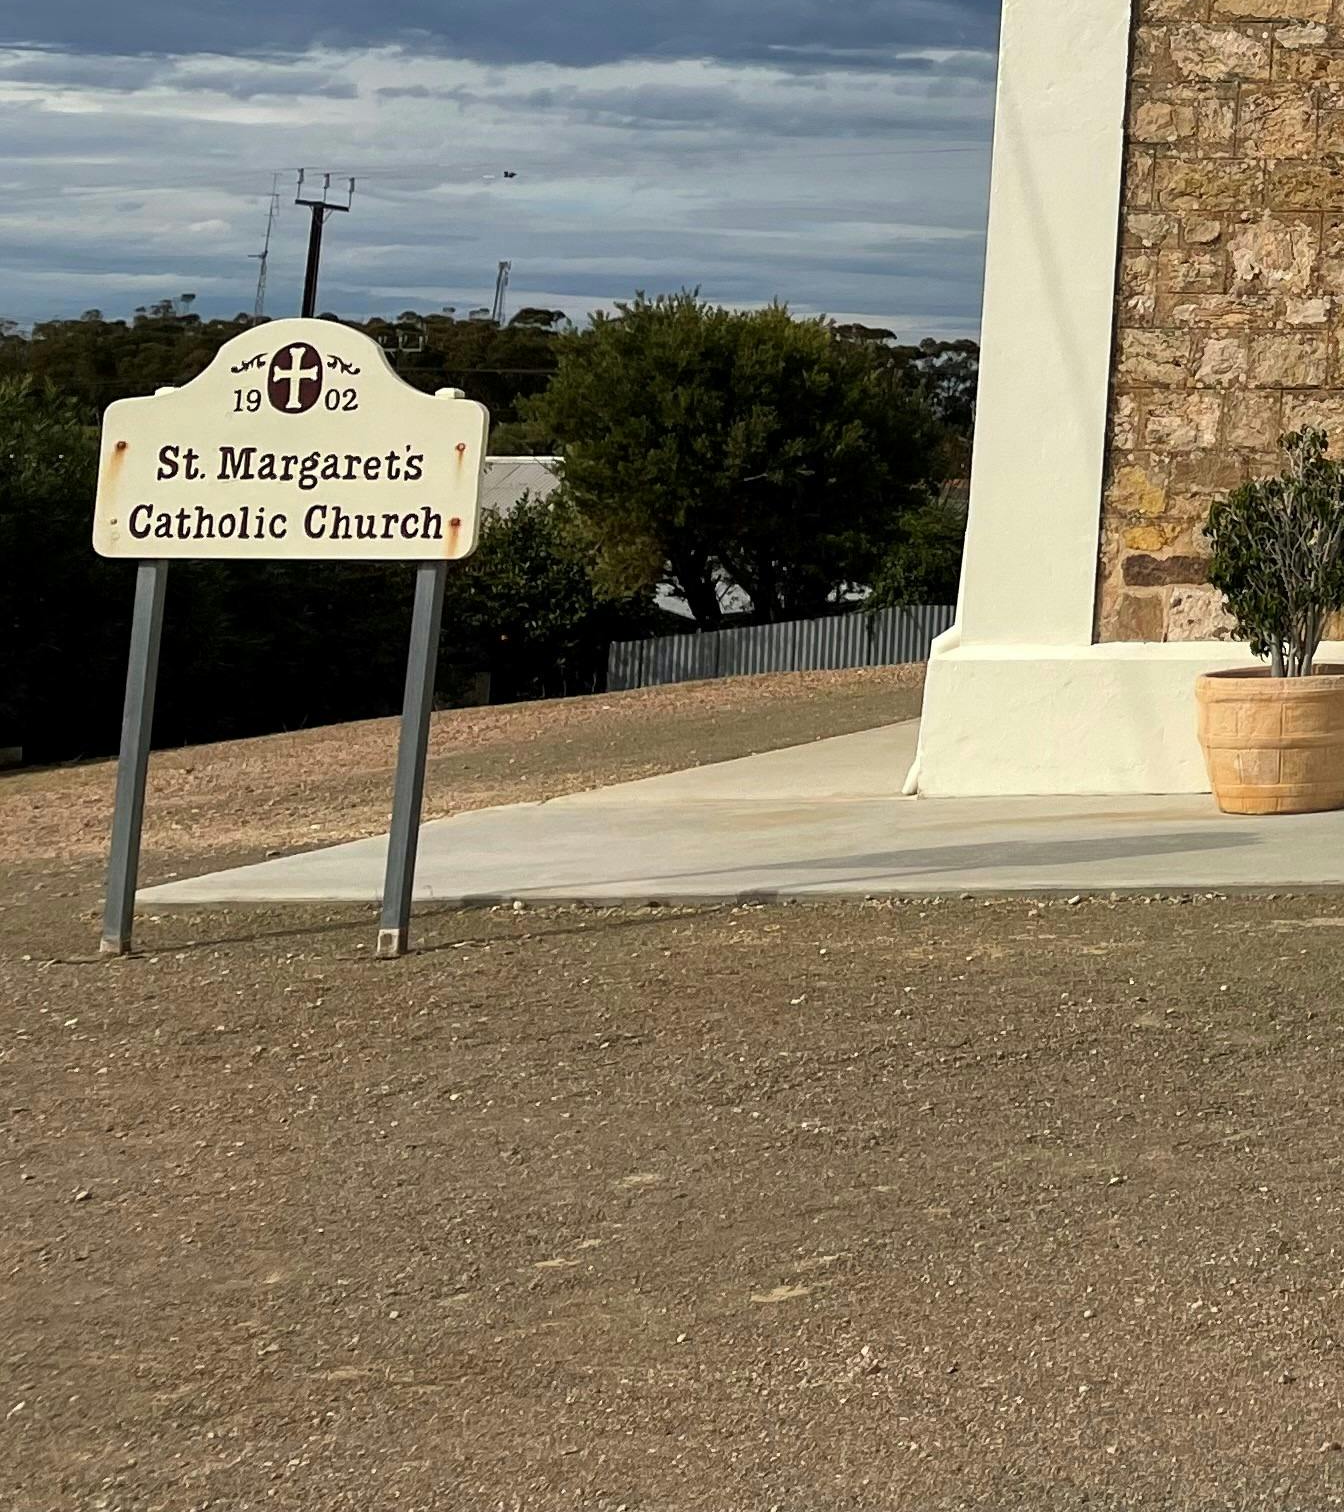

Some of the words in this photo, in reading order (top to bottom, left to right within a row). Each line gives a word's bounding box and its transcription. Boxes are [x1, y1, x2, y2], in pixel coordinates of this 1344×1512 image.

[233, 389, 262, 412] 19
[325, 389, 359, 412] 02
[157, 445, 207, 480] St.
[217, 445, 424, 490] Margaret's
[129, 503, 287, 539] Catholic
[304, 504, 443, 539] Church
